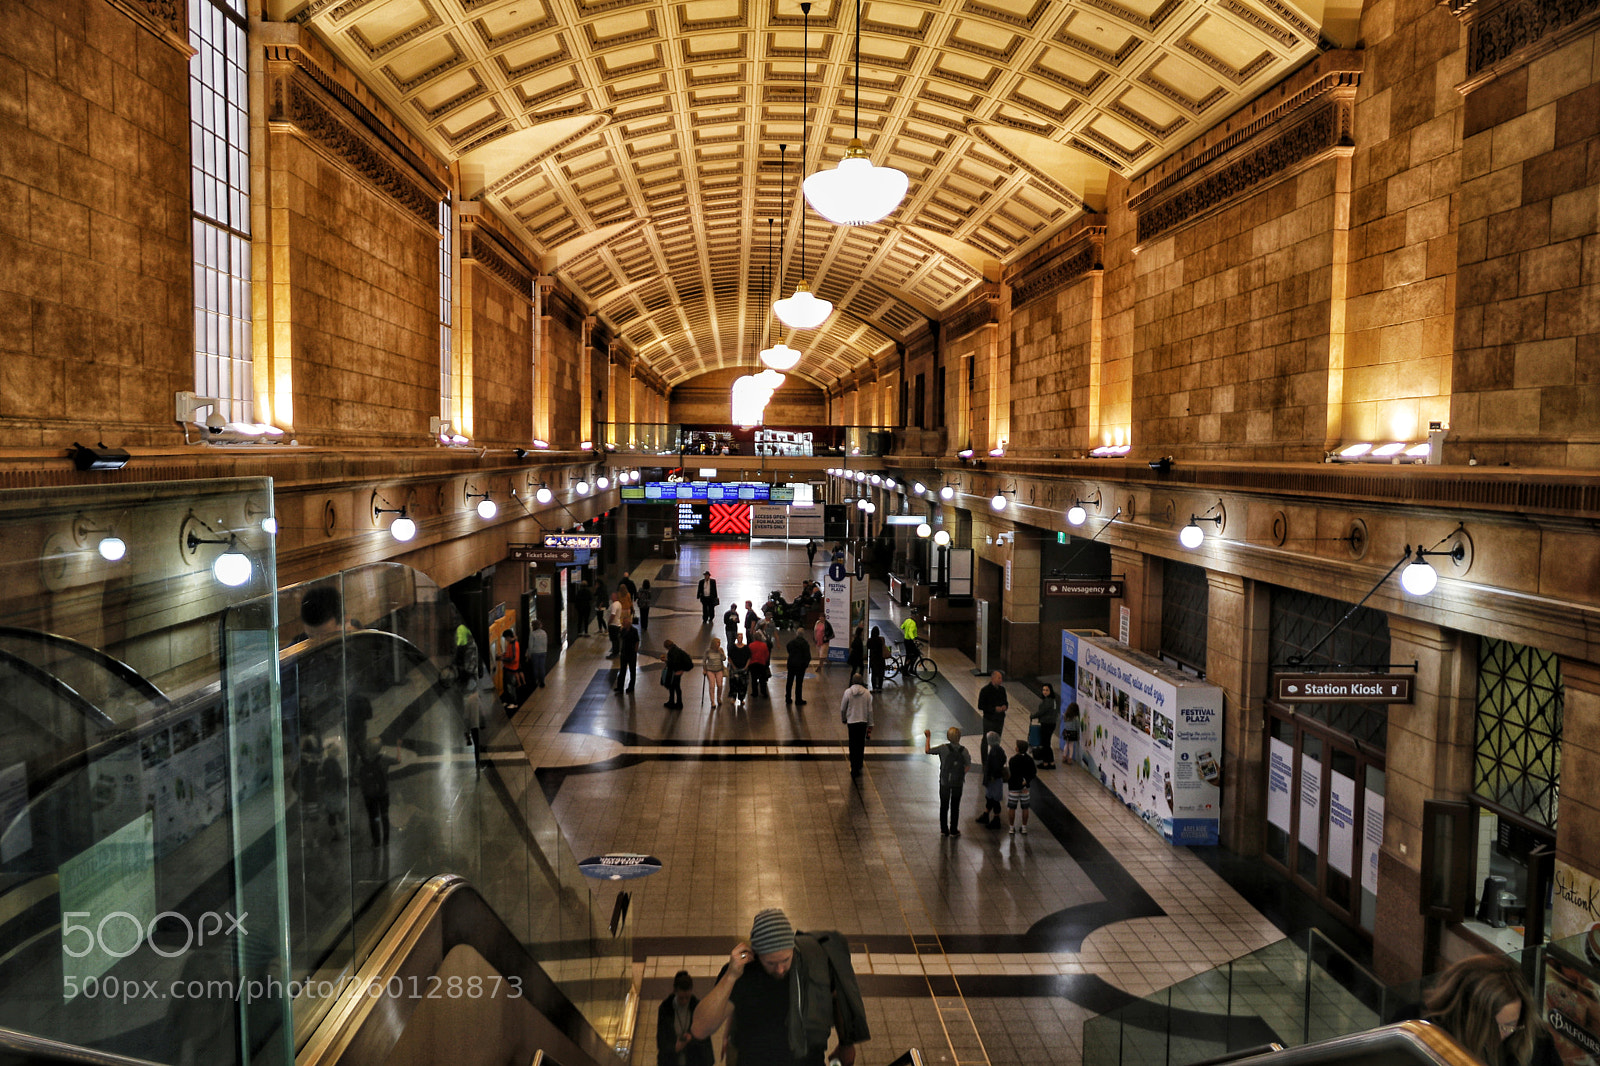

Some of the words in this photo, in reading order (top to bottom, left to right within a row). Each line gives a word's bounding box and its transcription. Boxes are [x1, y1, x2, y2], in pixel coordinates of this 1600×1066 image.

[1062, 585, 1105, 594] Newsagency
[1086, 648, 1100, 670] Creating
[1106, 661, 1117, 675] place
[1144, 683, 1153, 696] and
[1154, 690, 1165, 707] enjoy
[1304, 683, 1347, 694] Station
[1351, 683, 1383, 694] Kiosk
[1550, 1012, 1600, 1053] BALFOURS
